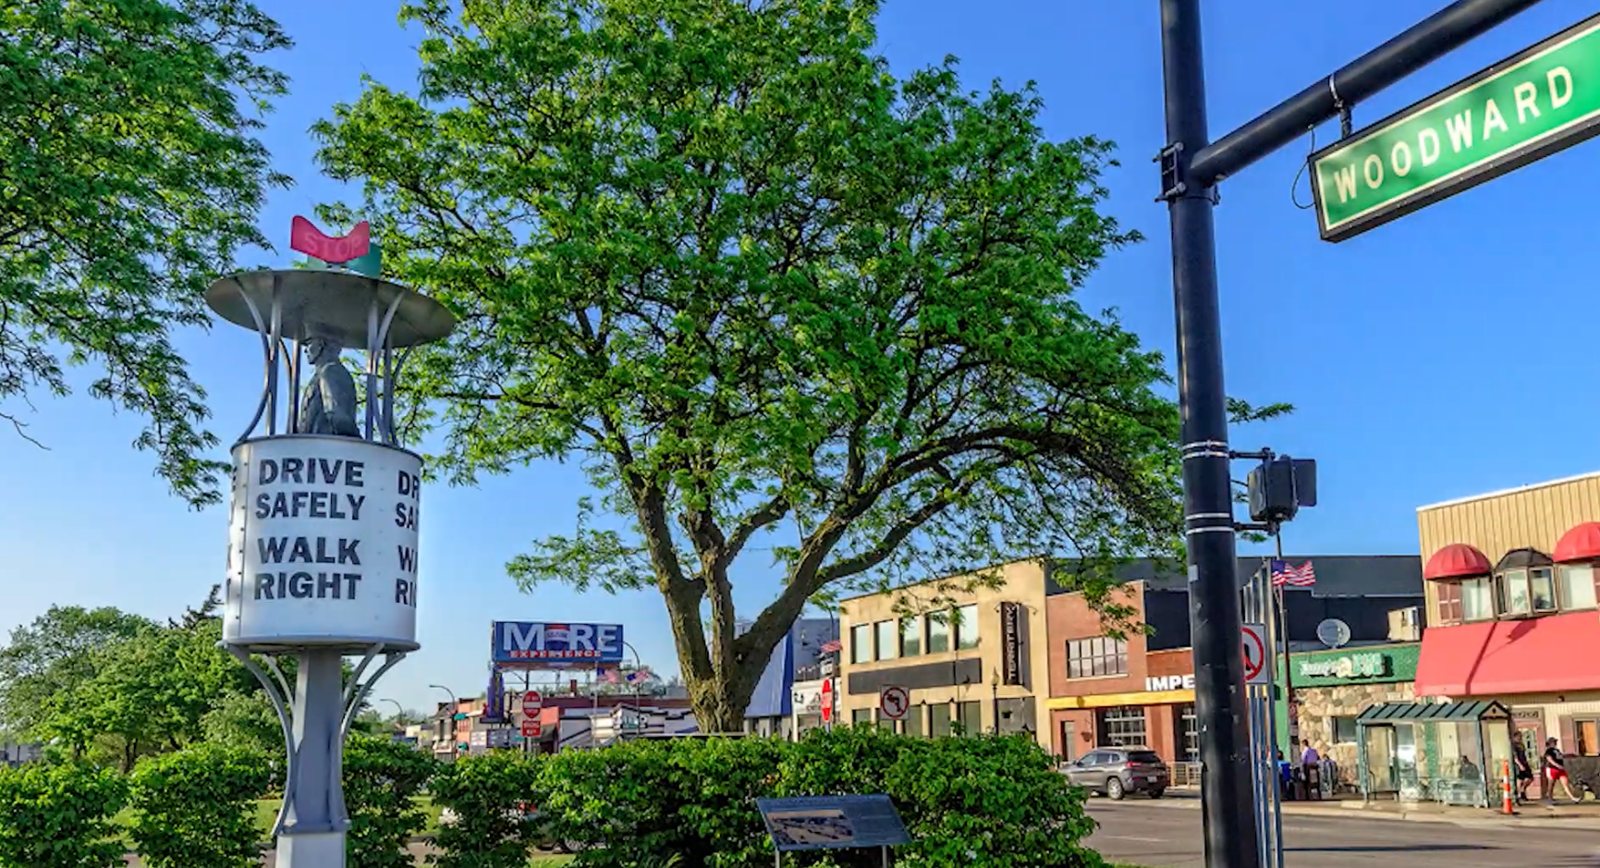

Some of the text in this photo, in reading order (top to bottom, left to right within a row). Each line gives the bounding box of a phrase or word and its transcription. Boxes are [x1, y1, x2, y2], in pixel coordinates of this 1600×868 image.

[1334, 66, 1574, 204] WOODWARD
[304, 232, 363, 258] STOP
[258, 457, 365, 487] DRIVE
[255, 491, 365, 521] SAFELY
[257, 536, 361, 565] WALK
[254, 571, 362, 600] RIGHT
[509, 650, 602, 659] EXPERIENCE
